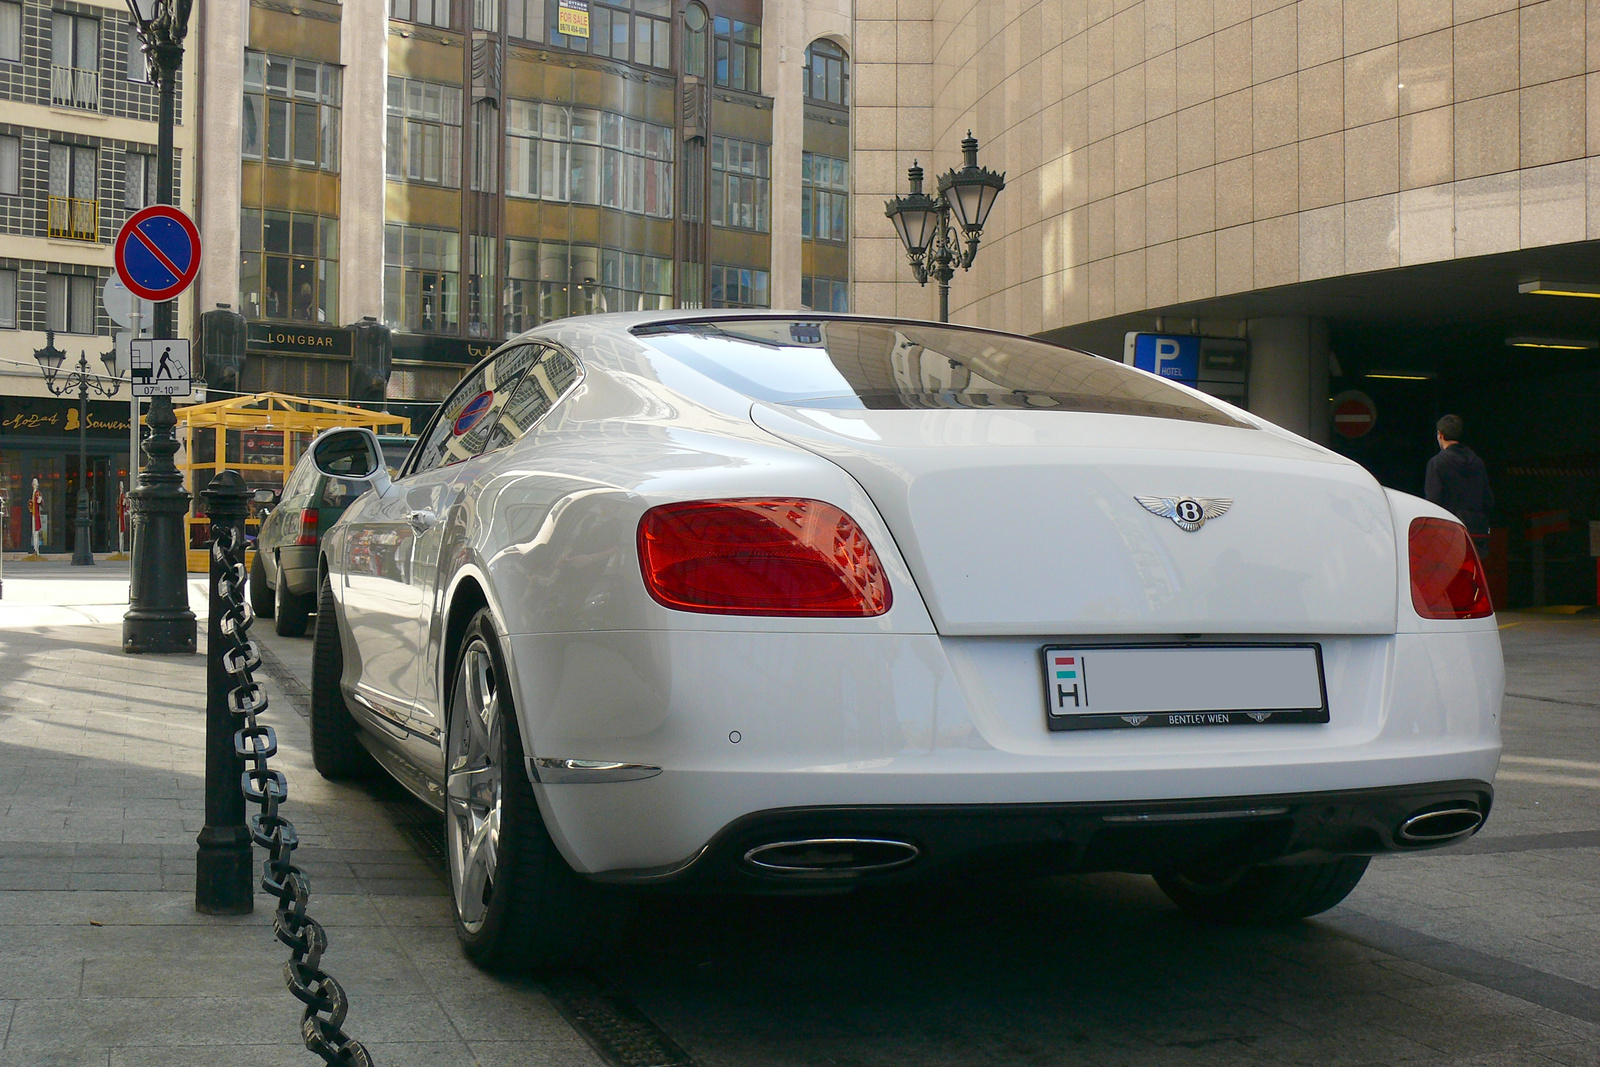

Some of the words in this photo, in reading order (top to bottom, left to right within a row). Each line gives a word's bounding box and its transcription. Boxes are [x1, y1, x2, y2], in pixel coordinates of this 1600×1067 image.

[559, 11, 572, 23] FOR
[573, 14, 588, 27] SALE
[268, 333, 333, 347] LONGBAR
[1154, 338, 1180, 375] P
[1161, 367, 1183, 377] HOTEL
[85, 412, 132, 430] Souveni
[1057, 683, 1079, 707] H
[1168, 713, 1205, 725] BENTLEY
[1208, 713, 1230, 724] WIEN
